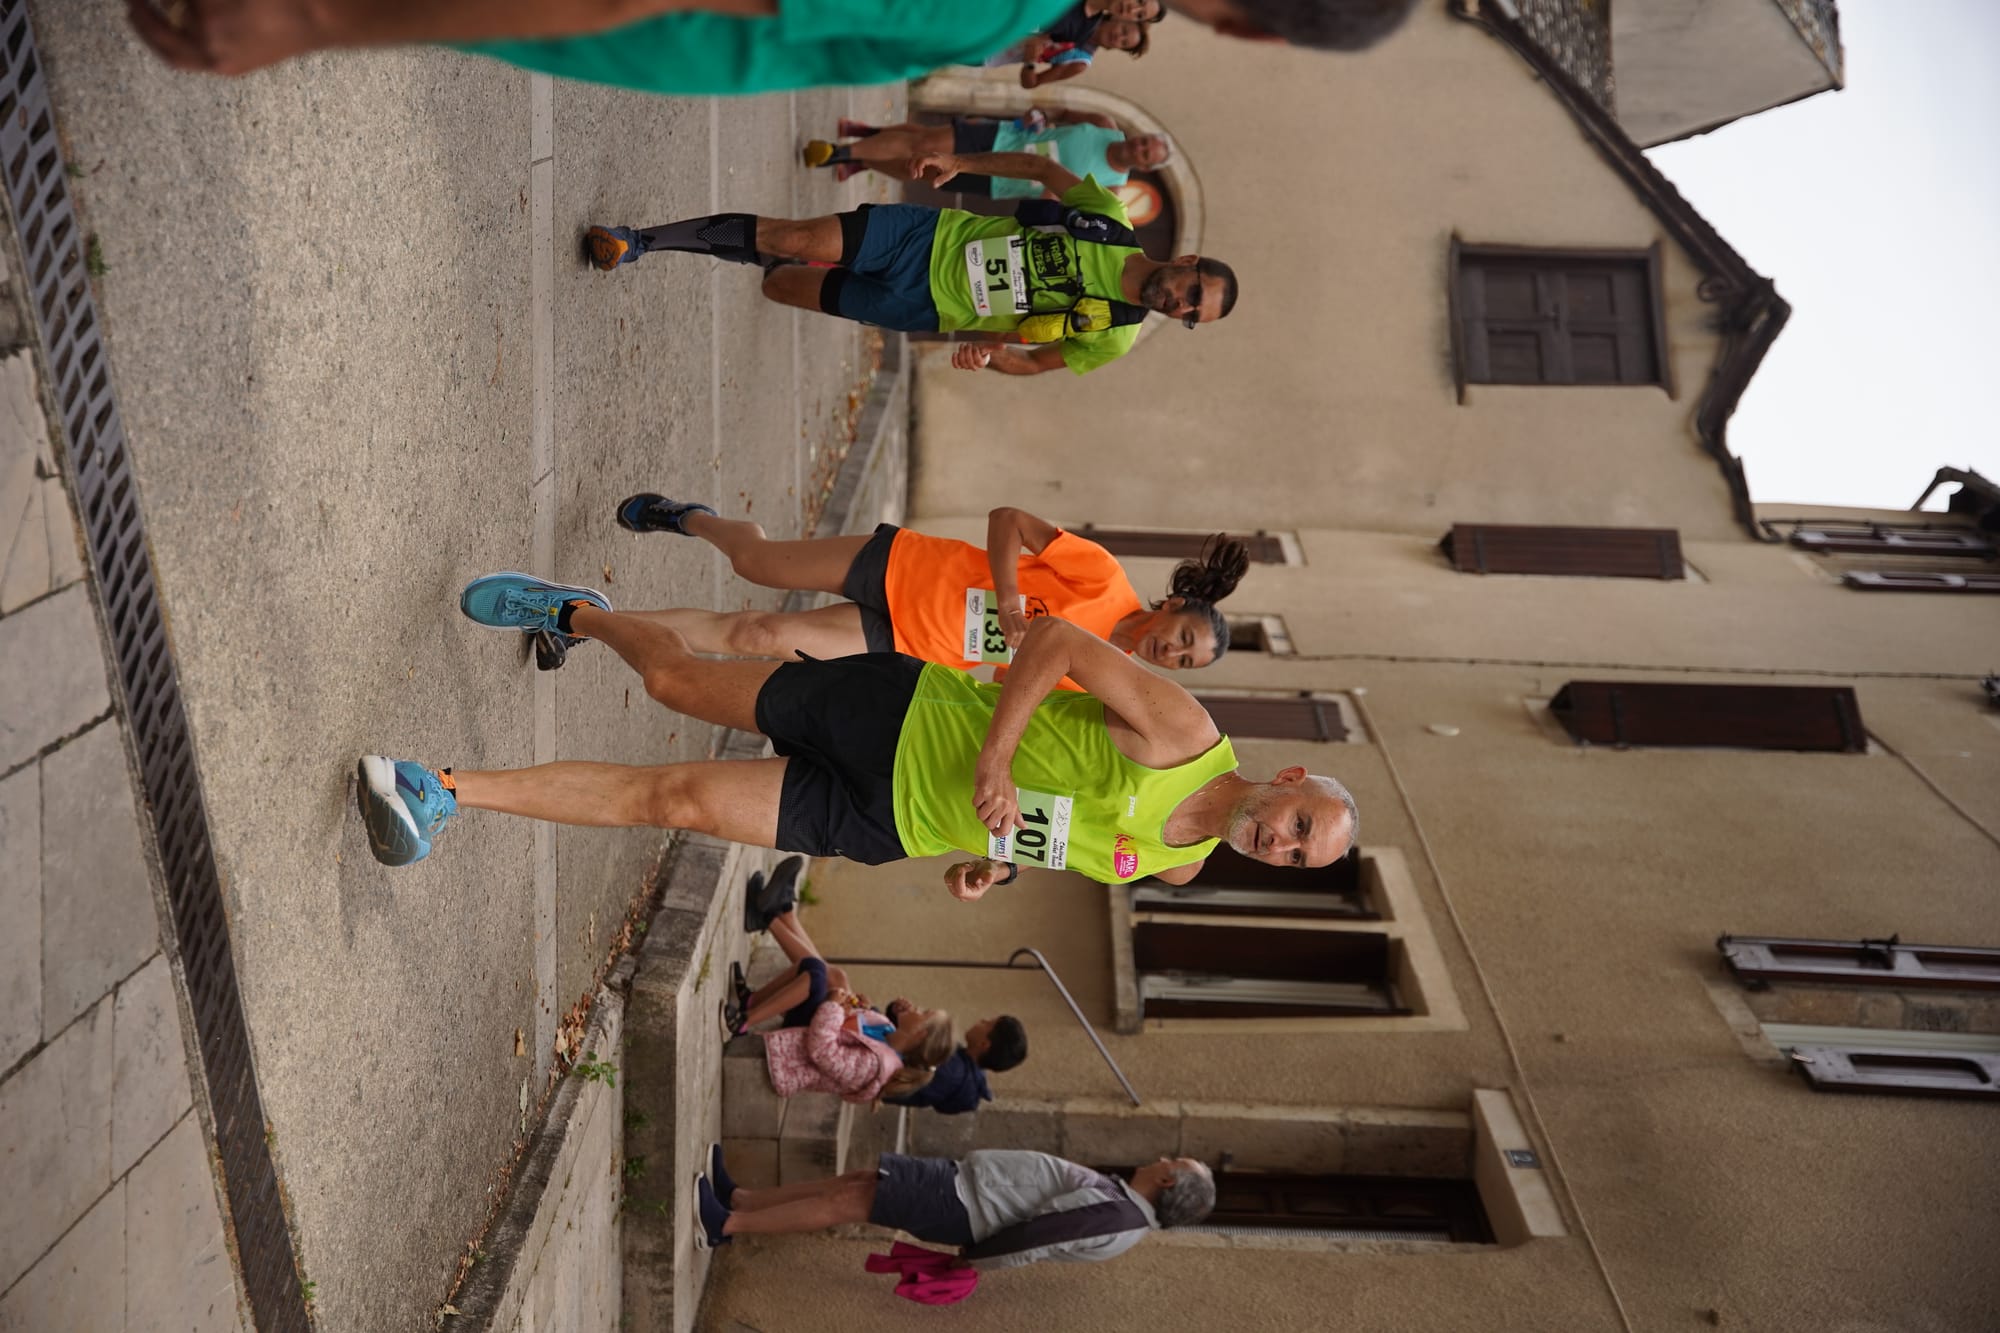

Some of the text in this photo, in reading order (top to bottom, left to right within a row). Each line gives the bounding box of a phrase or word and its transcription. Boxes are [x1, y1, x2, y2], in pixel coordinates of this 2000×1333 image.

[1049, 238, 1064, 266] TRAIL
[985, 259, 1010, 292] 51
[1015, 808, 1049, 862] 107
[1124, 856, 1136, 875] MARC
